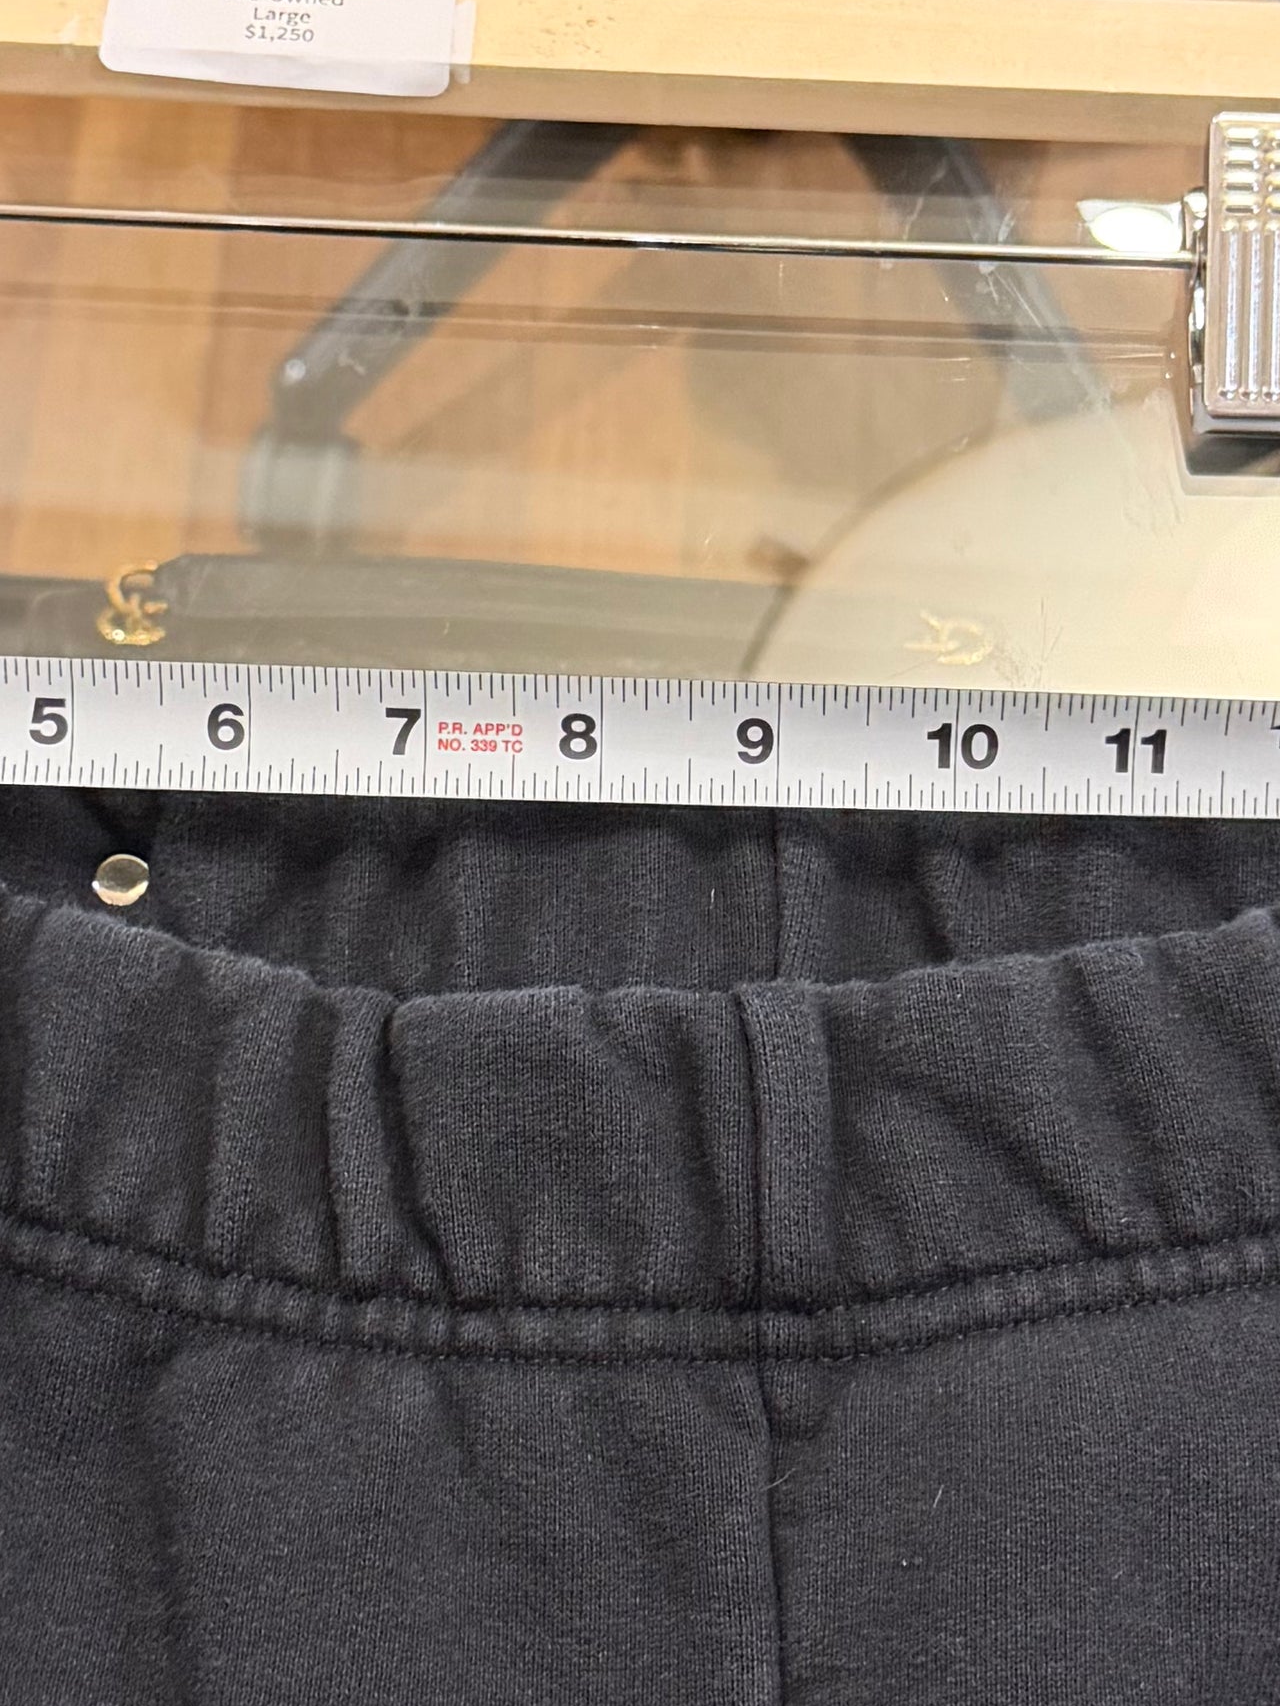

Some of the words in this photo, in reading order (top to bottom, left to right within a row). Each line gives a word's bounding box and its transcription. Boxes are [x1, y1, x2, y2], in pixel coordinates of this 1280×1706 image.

[254, 7, 311, 26] Large
[245, 24, 315, 42] $1,250
[29, 697, 69, 746] 5
[207, 702, 245, 751] 6
[385, 707, 421, 756] 7
[559, 713, 597, 760] 8
[736, 717, 775, 766] 9
[926, 722, 998, 771] 10
[1106, 726, 1167, 775] 11
[438, 721, 467, 735] P.R.
[473, 723, 523, 737] APP'D
[438, 738, 465, 752] NO.
[471, 739, 497, 753] 339
[502, 740, 523, 753] TC
